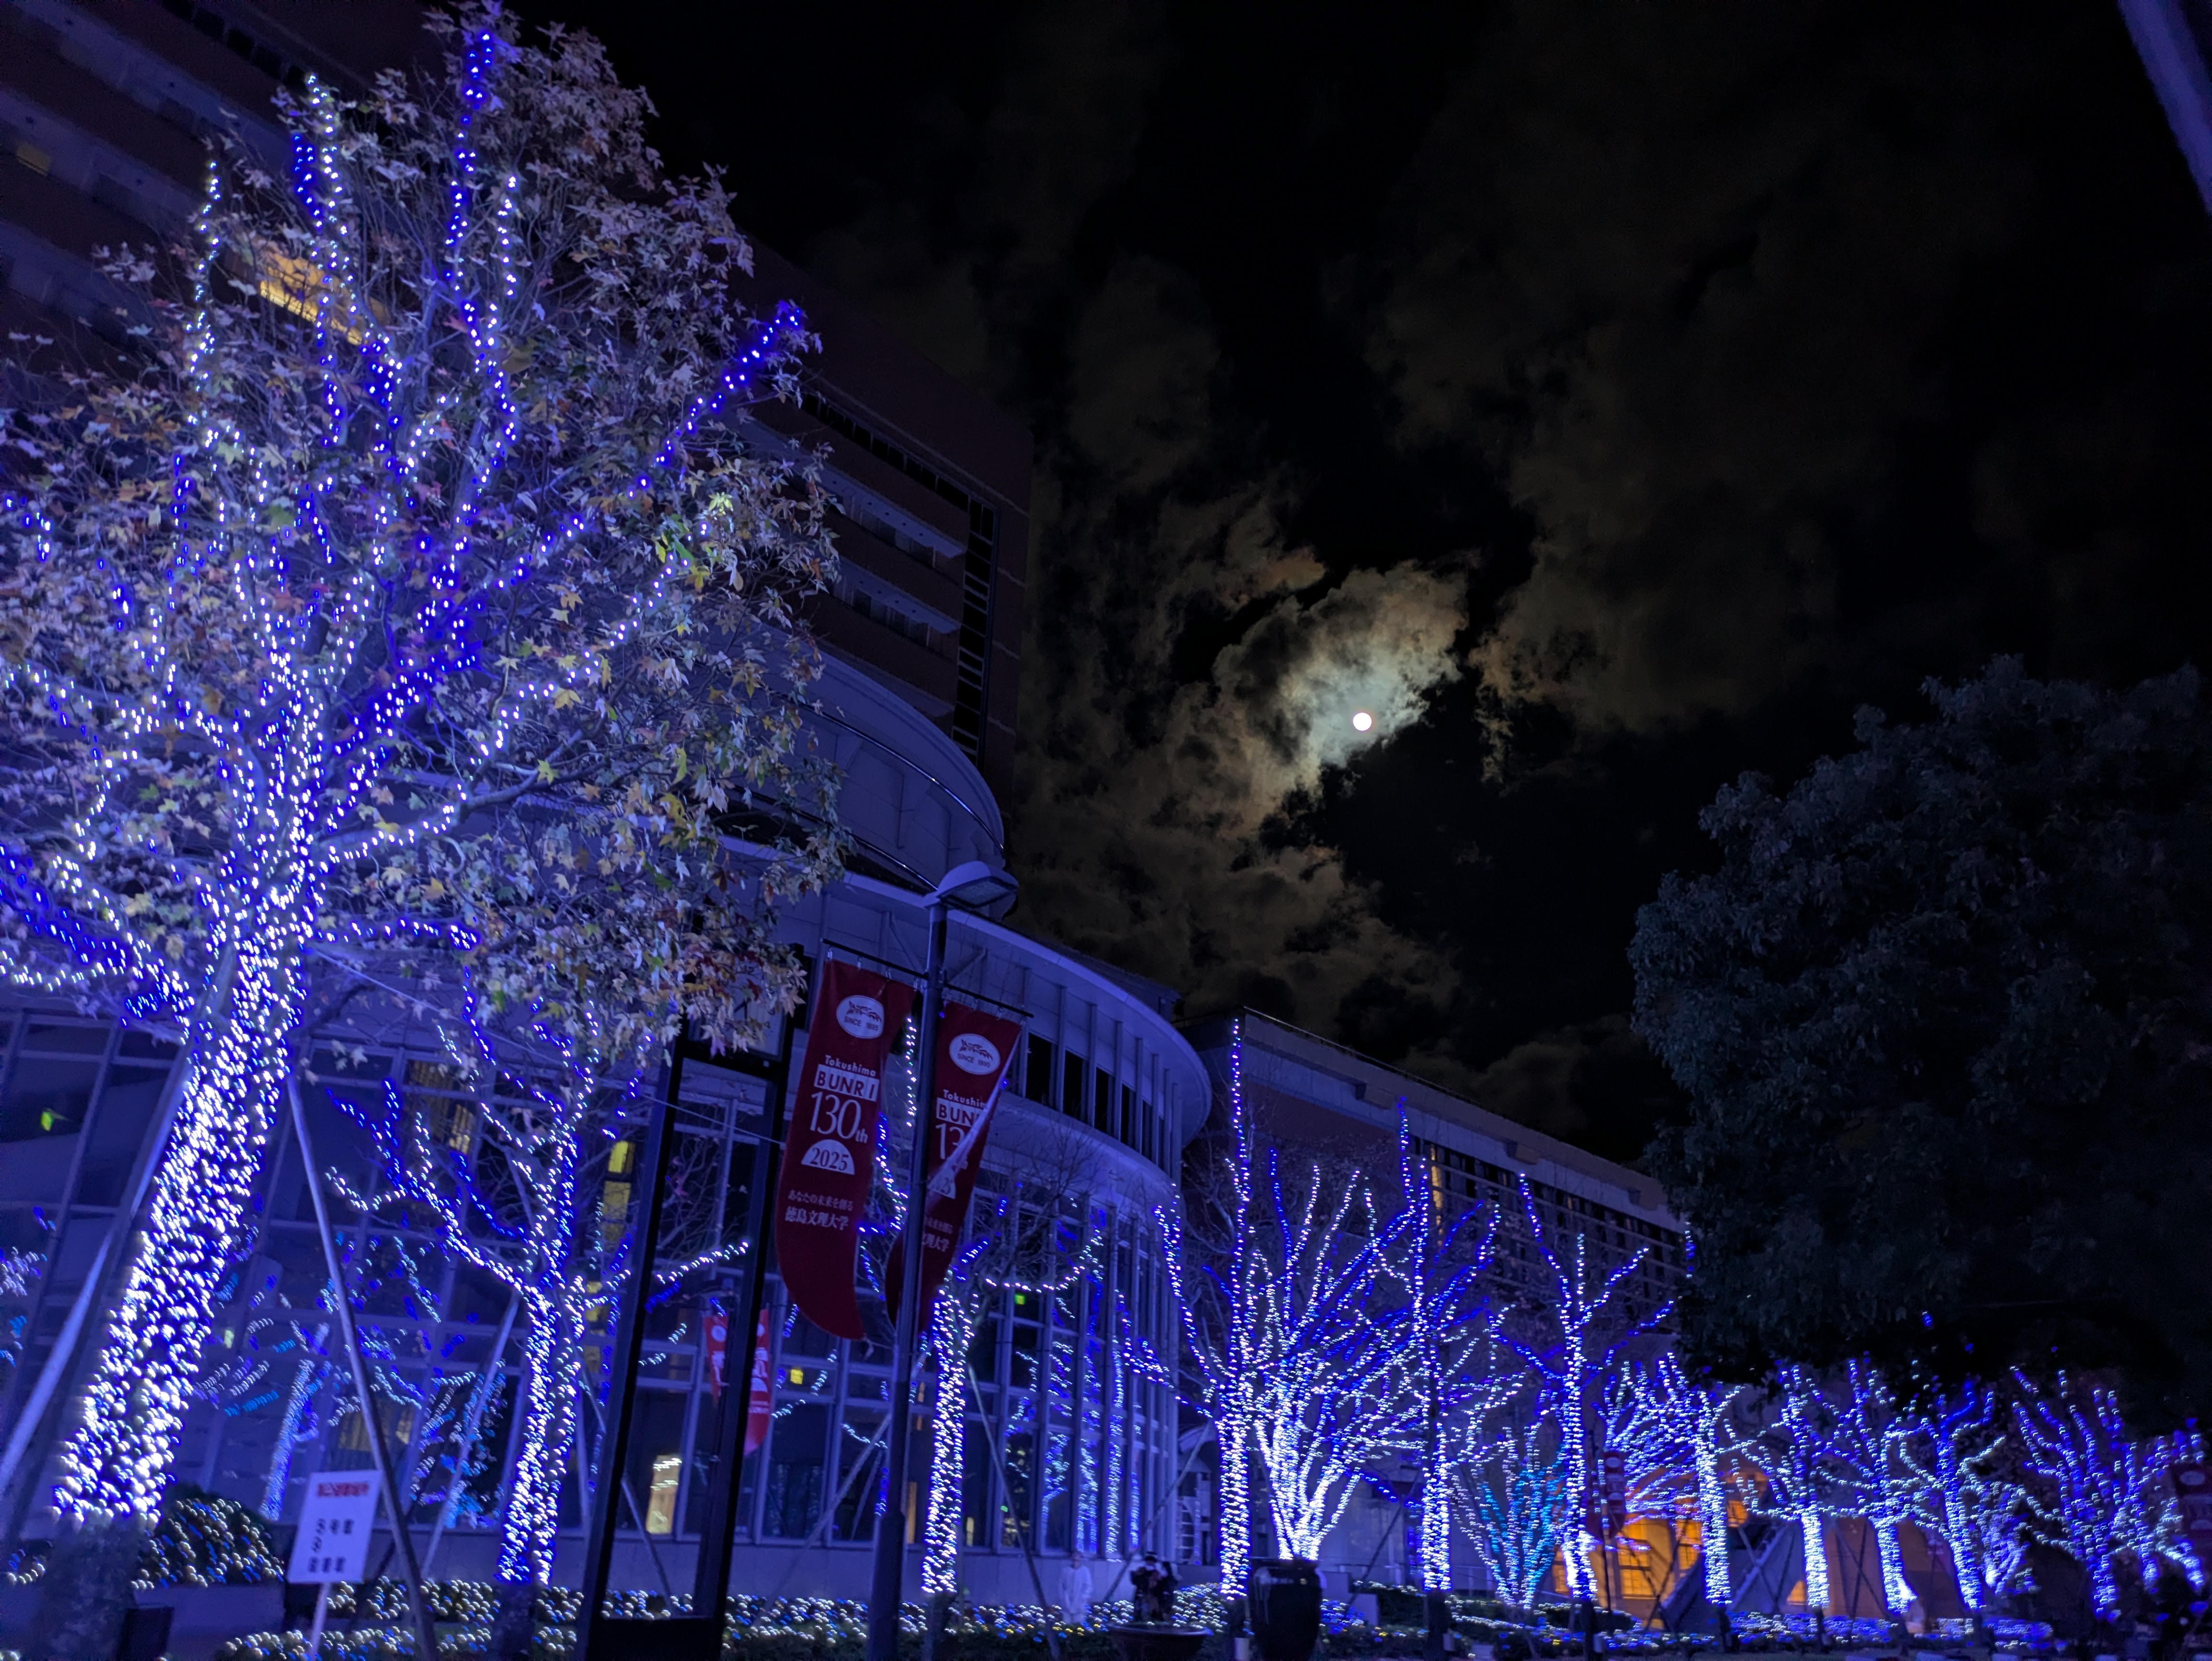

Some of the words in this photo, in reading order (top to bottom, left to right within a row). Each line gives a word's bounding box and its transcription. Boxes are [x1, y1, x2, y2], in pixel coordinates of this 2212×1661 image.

[844, 1016, 862, 1027] SINCE
[825, 1054, 876, 1076] Tokushima
[957, 1053, 974, 1063] SINCE
[978, 1060, 990, 1068] 1895
[817, 1071, 875, 1099] BUNRI
[810, 1091, 868, 1143] 130th
[935, 1123, 966, 1160] 13
[810, 1147, 849, 1171] 2025
